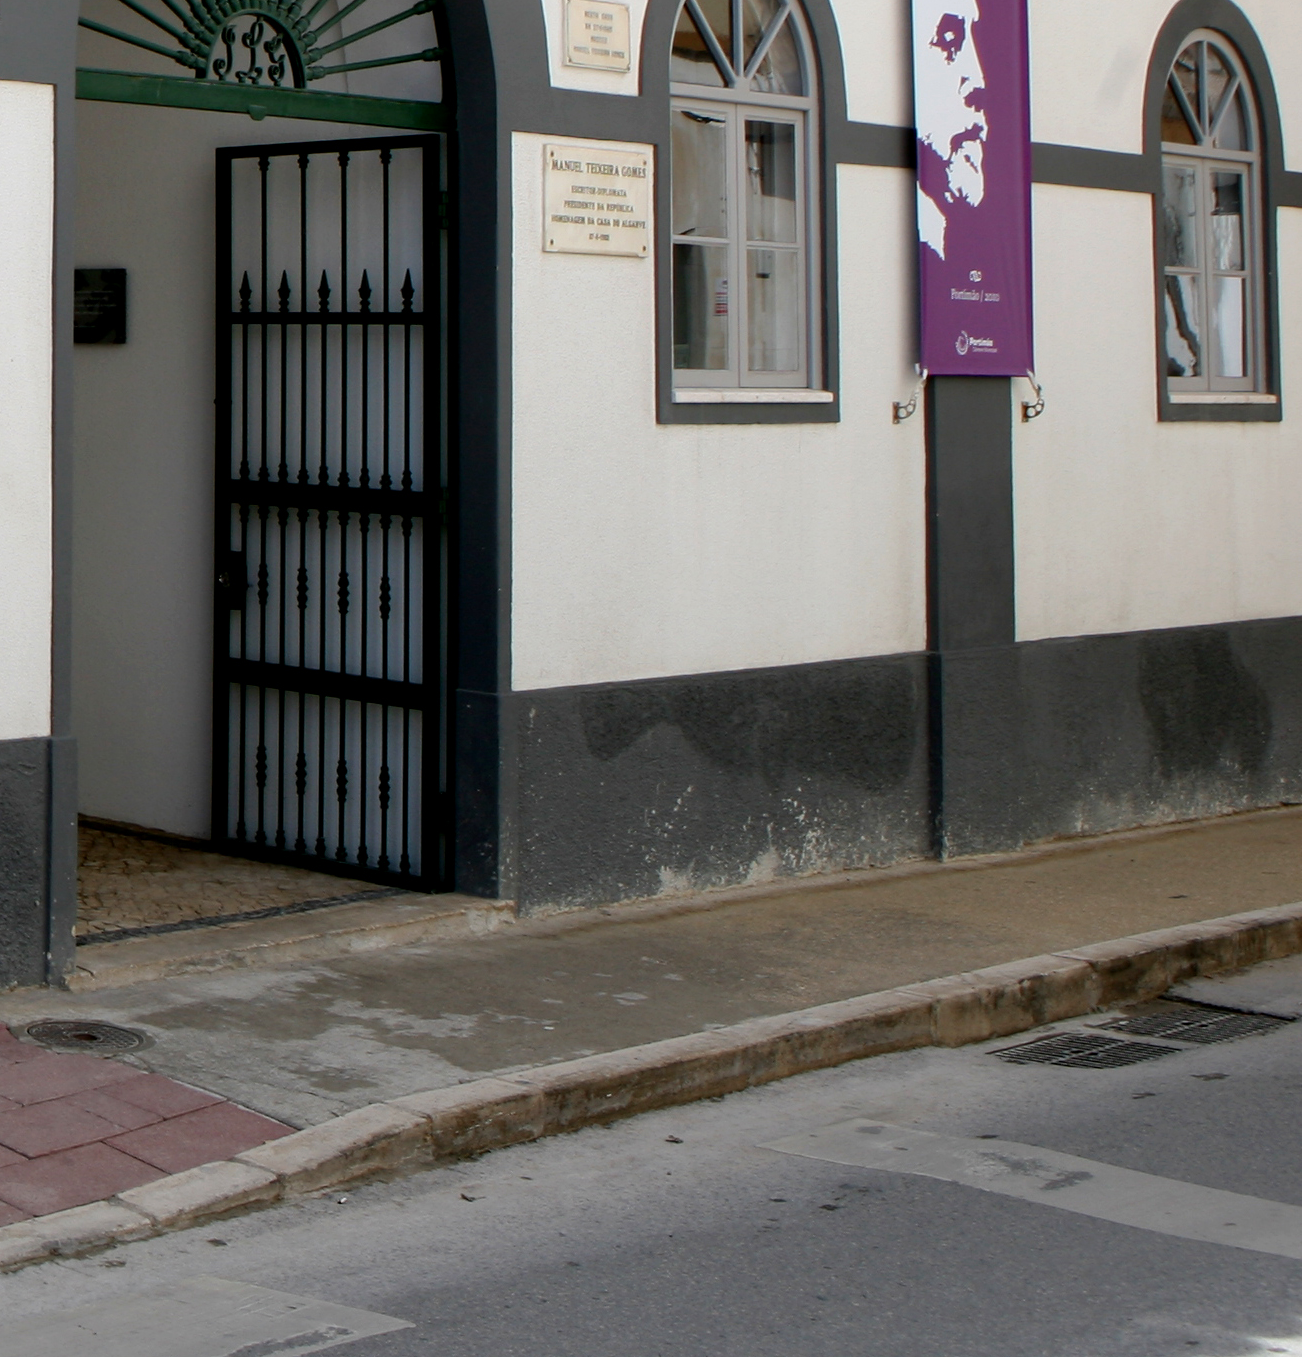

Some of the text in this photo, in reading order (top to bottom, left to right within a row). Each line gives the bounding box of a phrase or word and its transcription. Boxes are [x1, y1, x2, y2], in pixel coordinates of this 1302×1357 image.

[551, 159, 646, 179] MANUEL TEIXEIRA GOMES
